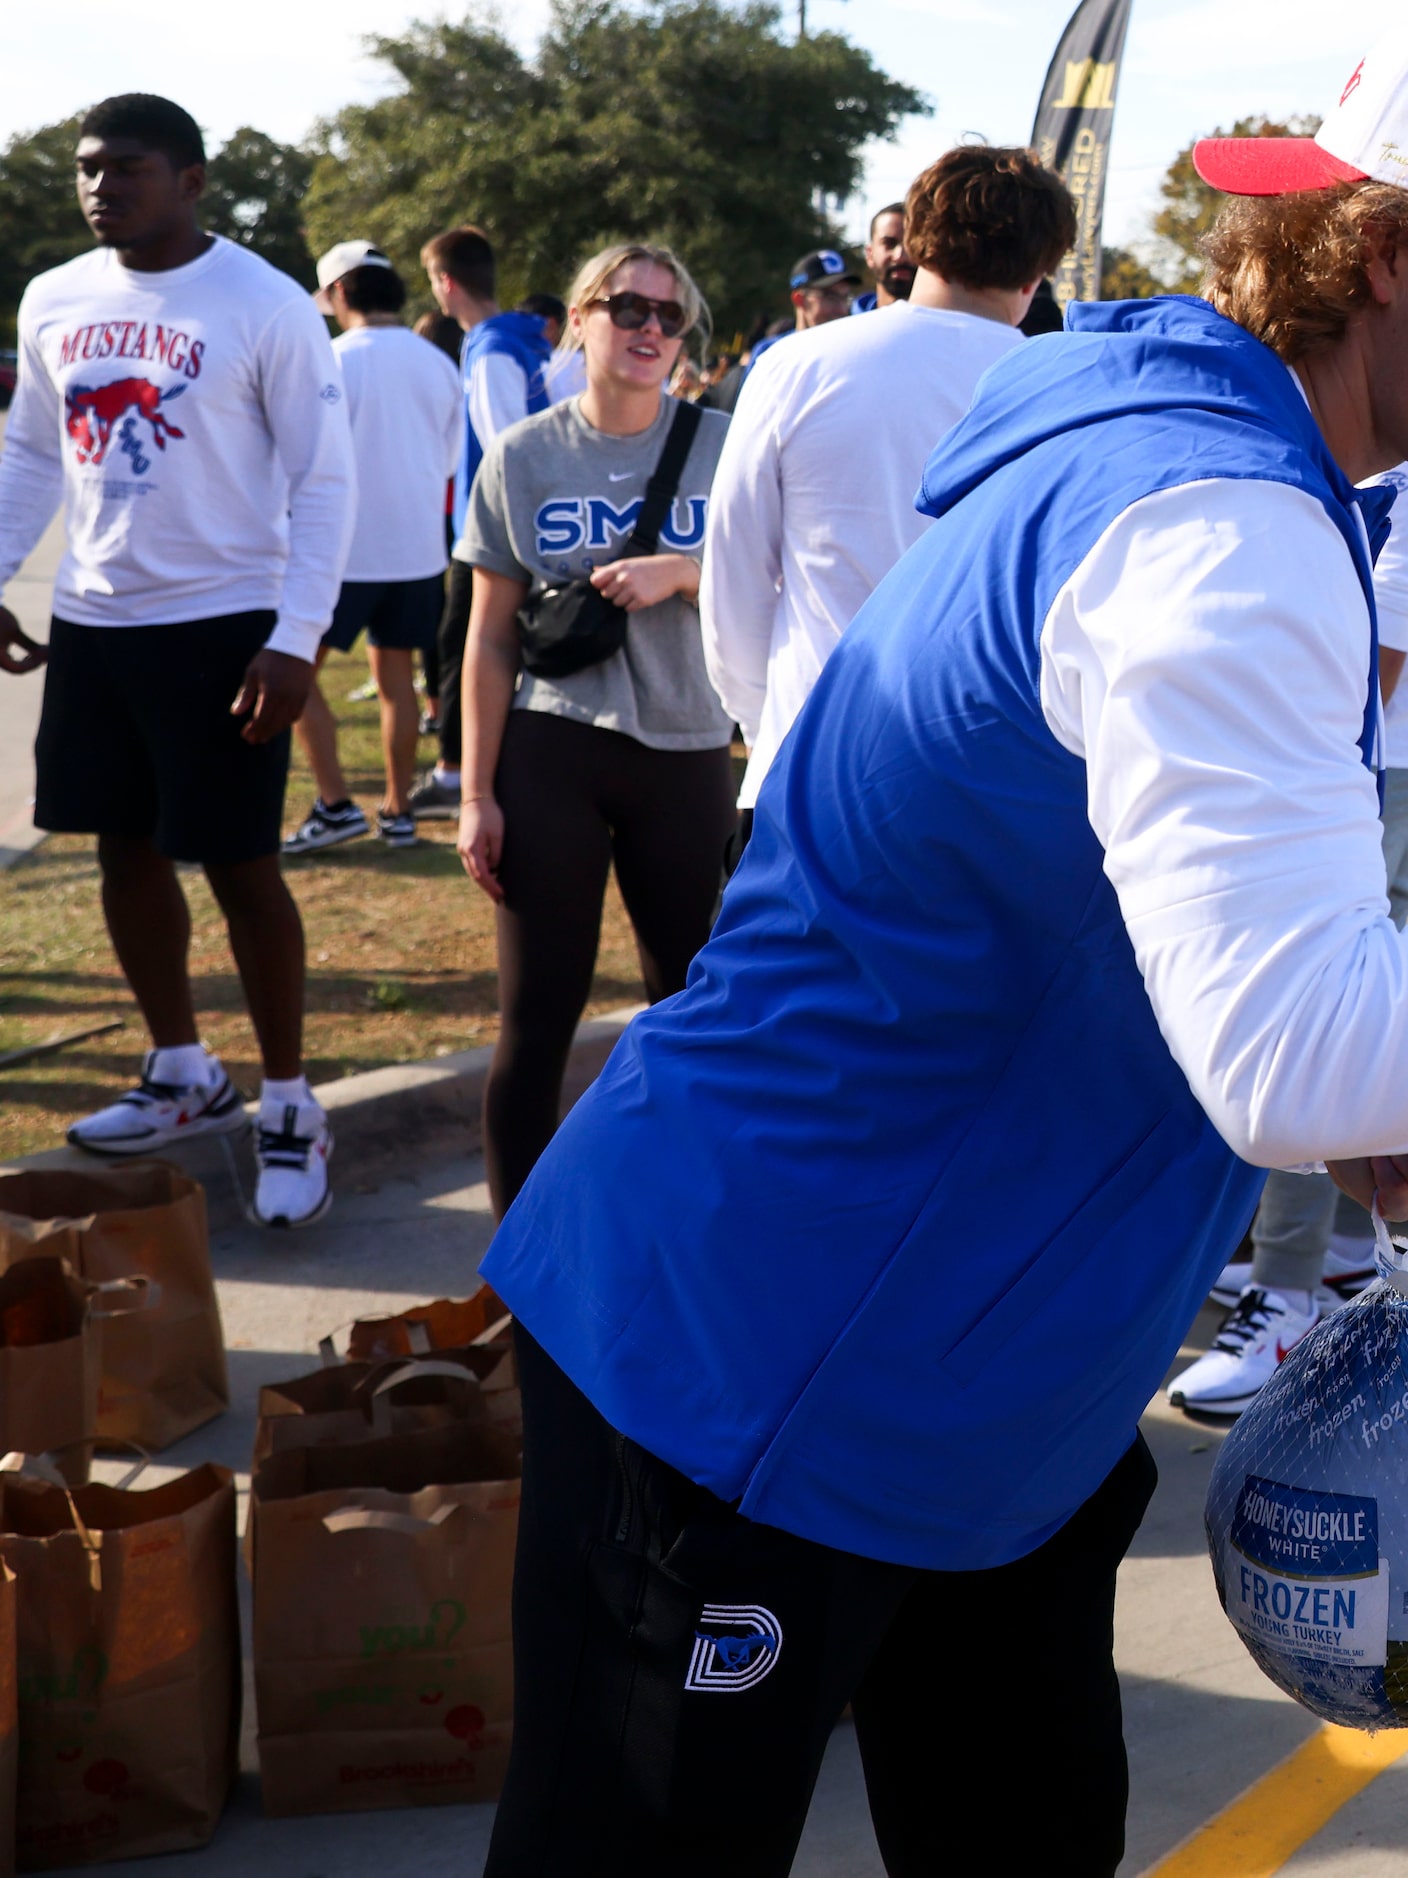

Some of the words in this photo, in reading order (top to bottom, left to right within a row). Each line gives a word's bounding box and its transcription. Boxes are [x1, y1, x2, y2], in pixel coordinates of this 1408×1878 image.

[59, 320, 206, 380] MUSTANGS
[534, 495, 709, 556] SMU
[1326, 1373, 1350, 1397] frozen
[1273, 1395, 1322, 1432] frozen
[1308, 1393, 1367, 1449] frozen
[1242, 1490, 1366, 1542] HONEYSUCKLE
[1240, 1565, 1356, 1629] FROZEN
[360, 1599, 467, 1669] you?
[1250, 1611, 1289, 1637] YOUNG
[1293, 1625, 1343, 1647] TURKEY
